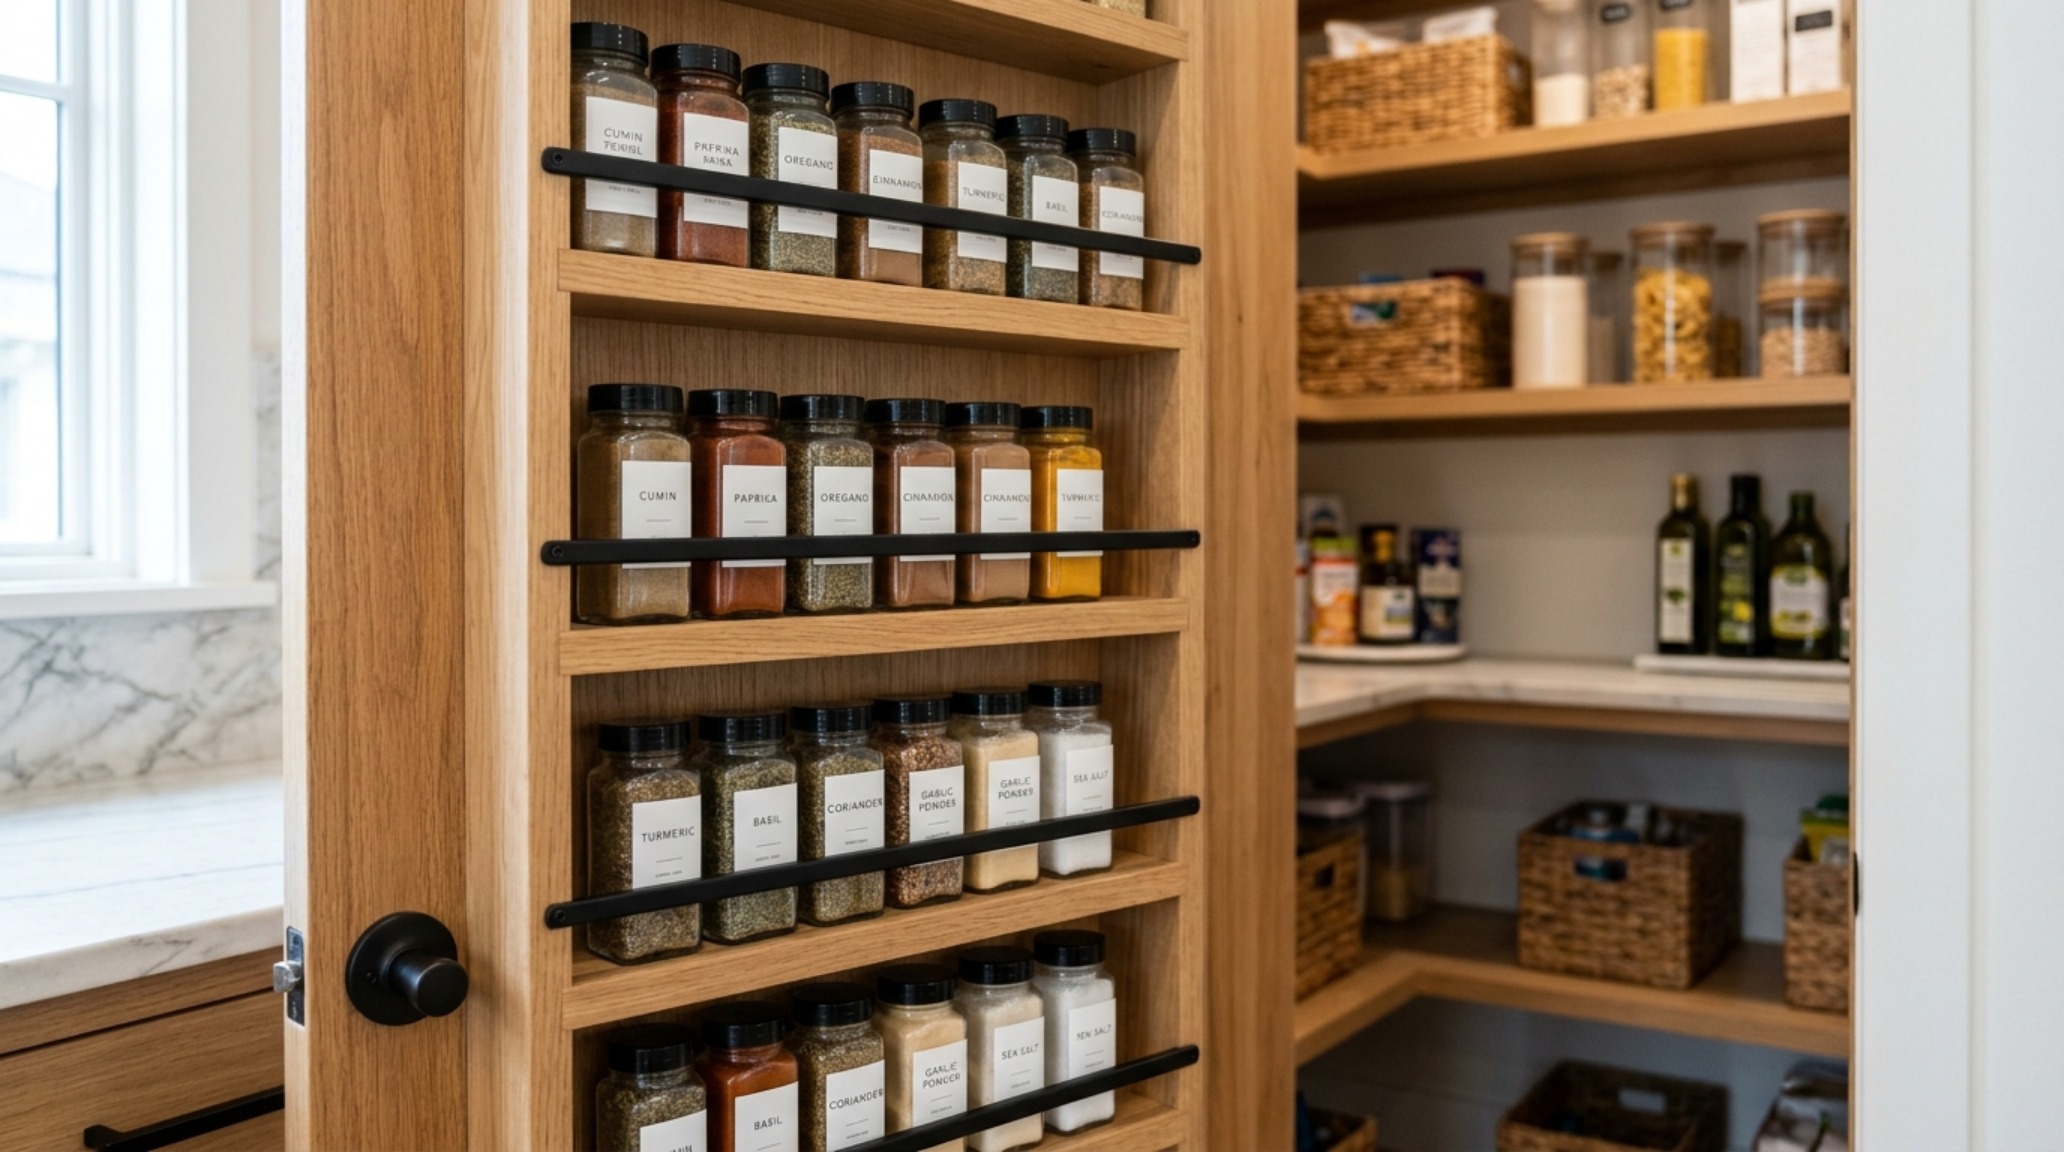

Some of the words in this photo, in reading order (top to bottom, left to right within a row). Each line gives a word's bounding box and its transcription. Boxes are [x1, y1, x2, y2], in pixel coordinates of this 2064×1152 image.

[604, 127, 643, 142] CUMIN
[639, 490, 677, 502] CUMIN
[820, 493, 869, 503] OREGANO
[641, 826, 696, 843] TURMERIC
[1001, 1049, 1018, 1060] SEA
[753, 1116, 782, 1131] BASIL
